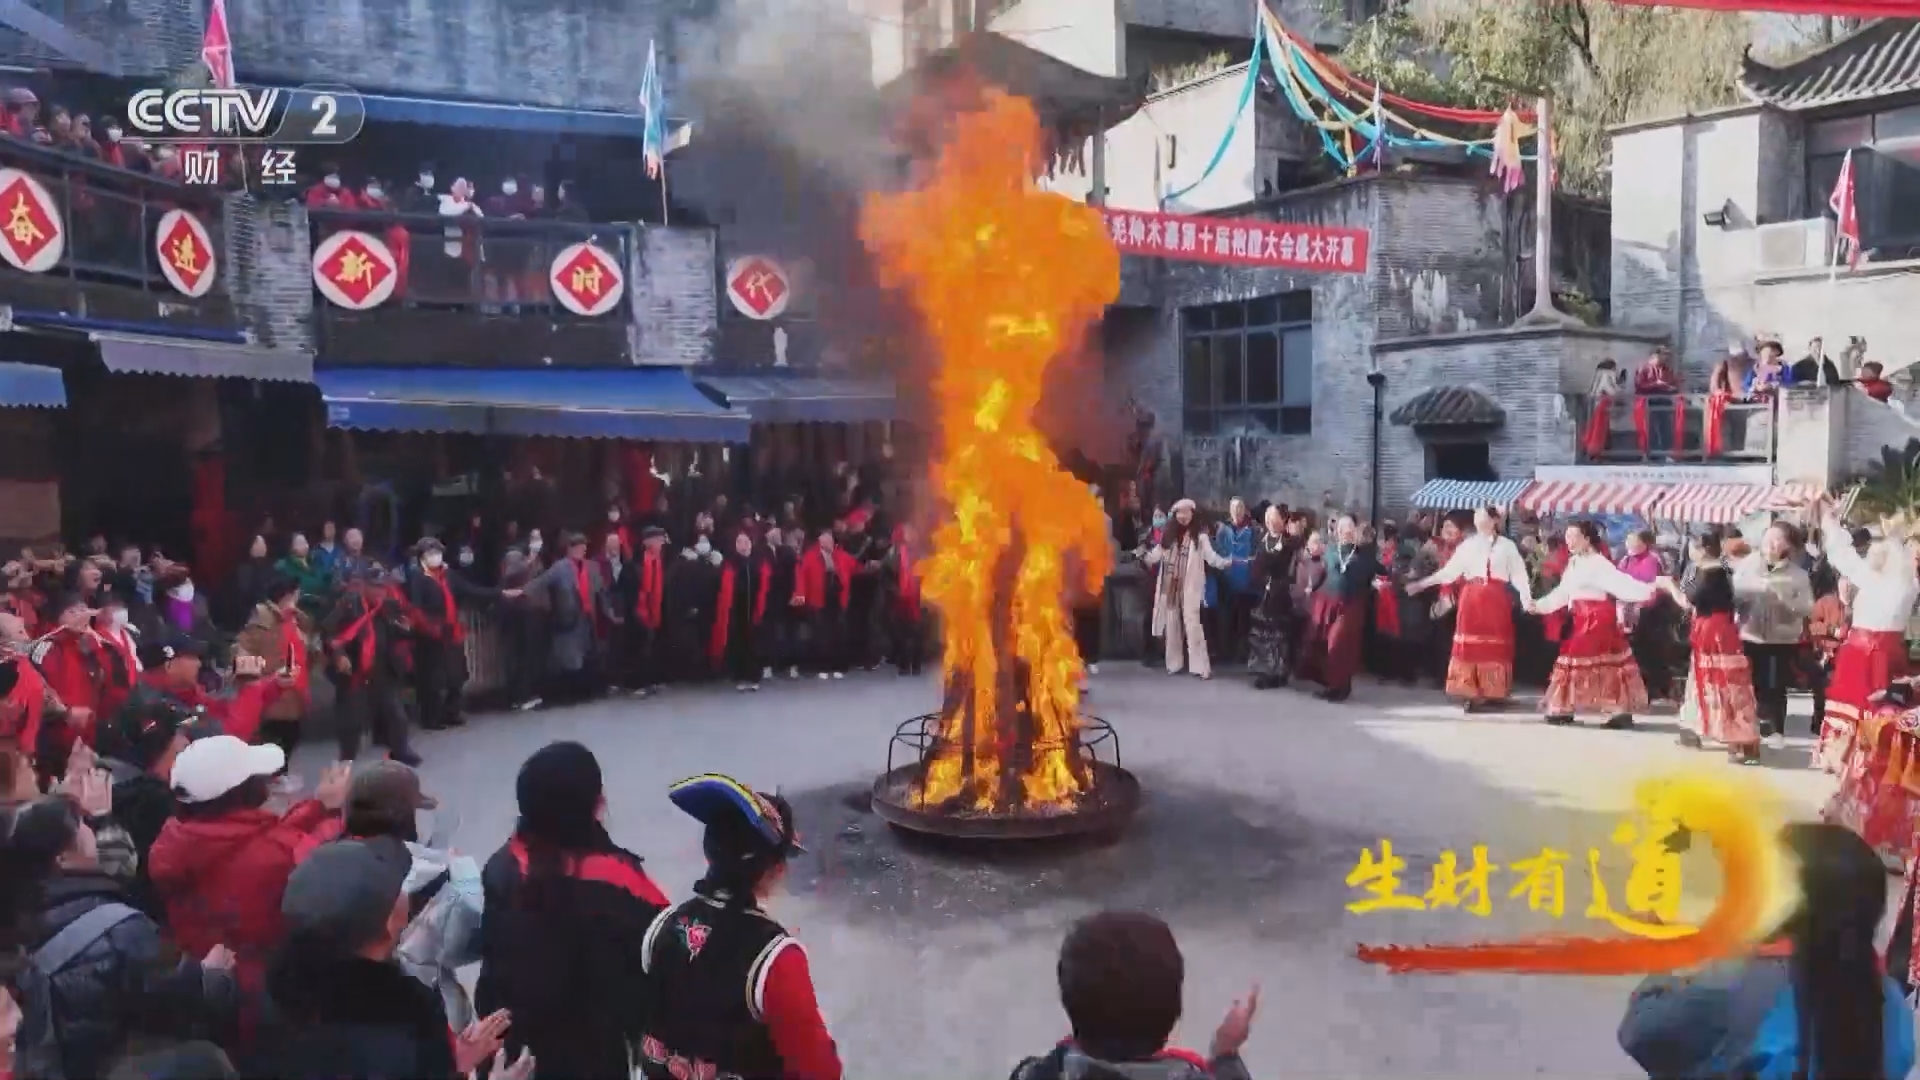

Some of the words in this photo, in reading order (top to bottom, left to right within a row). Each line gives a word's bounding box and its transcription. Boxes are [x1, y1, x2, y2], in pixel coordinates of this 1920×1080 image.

[172, 233, 203, 275] 进
[335, 249, 377, 290] 新
[571, 263, 604, 297] 时
[745, 271, 774, 303] 代
